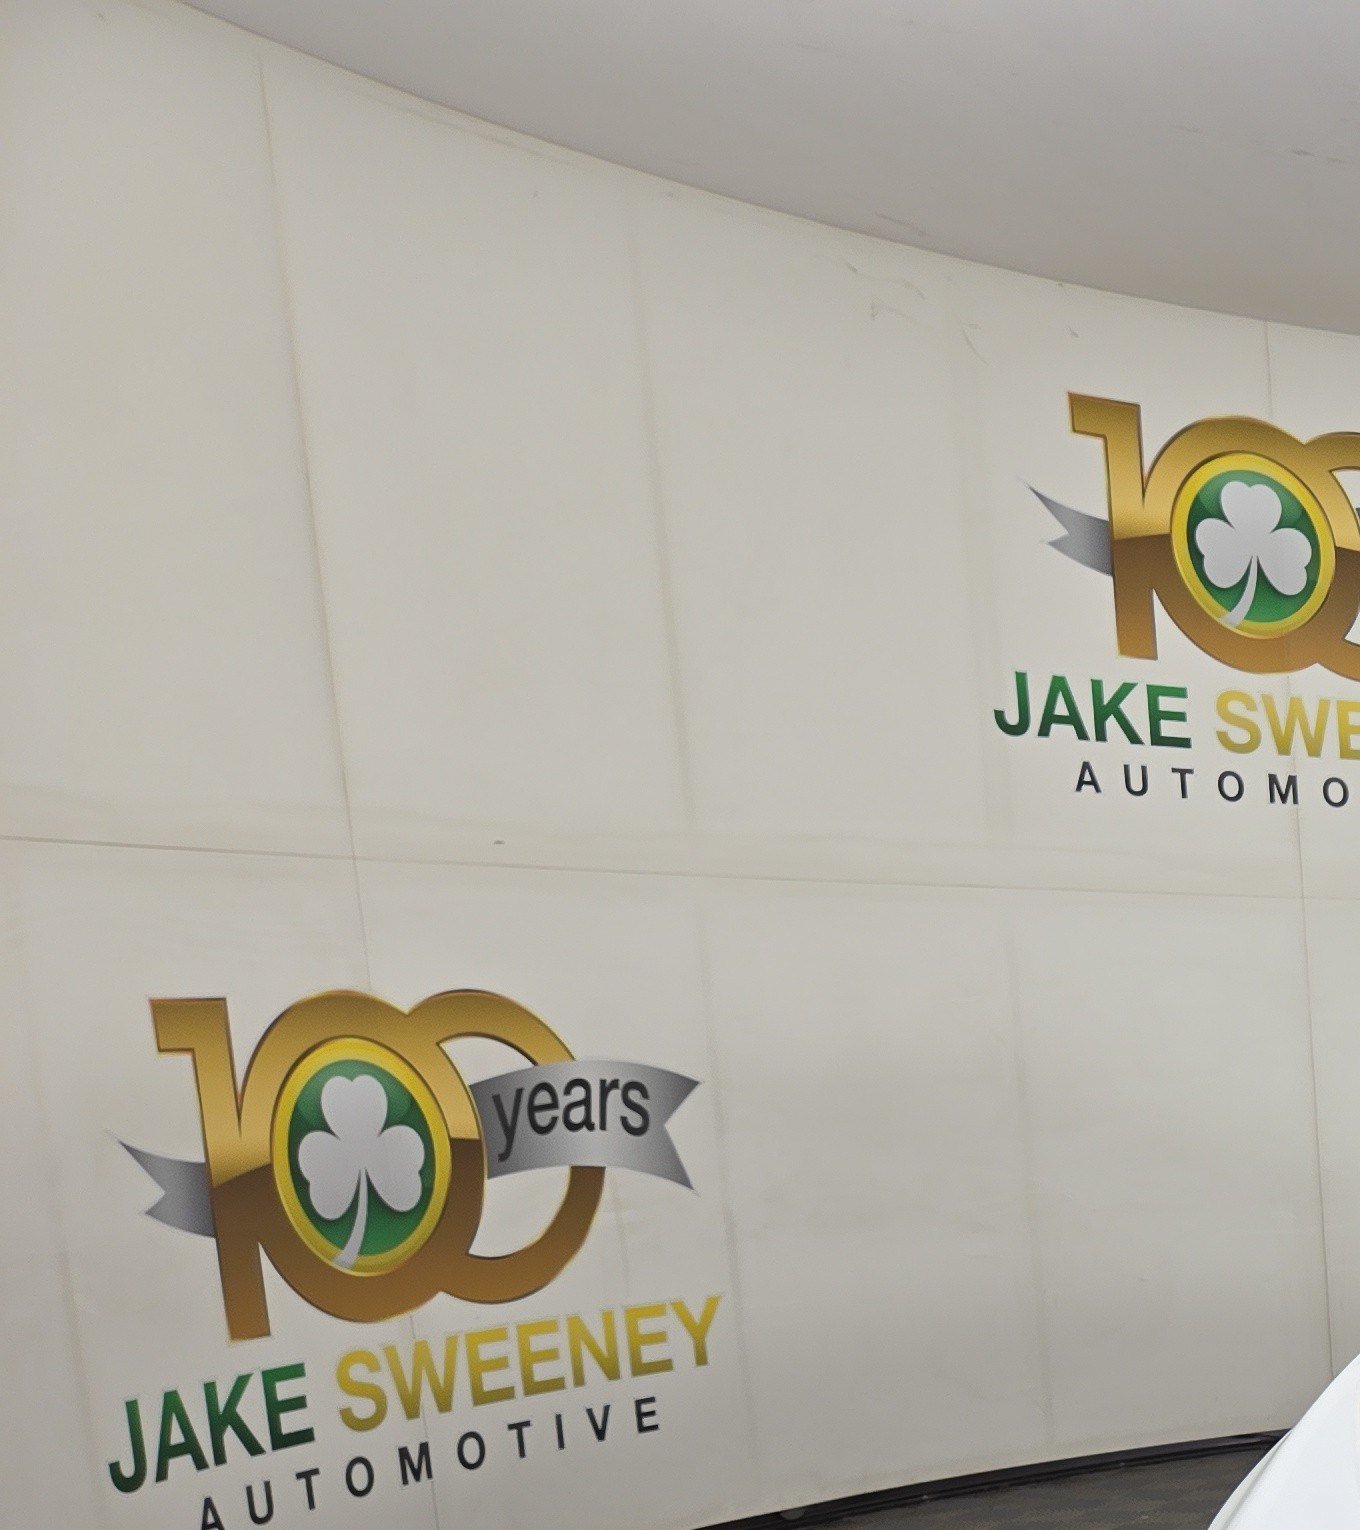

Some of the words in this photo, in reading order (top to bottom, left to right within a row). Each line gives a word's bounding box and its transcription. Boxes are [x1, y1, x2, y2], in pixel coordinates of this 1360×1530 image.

[994, 671, 1192, 748] JAKE
[149, 988, 606, 1342] 100
[491, 1077, 650, 1161] years
[107, 1363, 315, 1494] JAKE
[336, 1295, 722, 1433] SWEENEY
